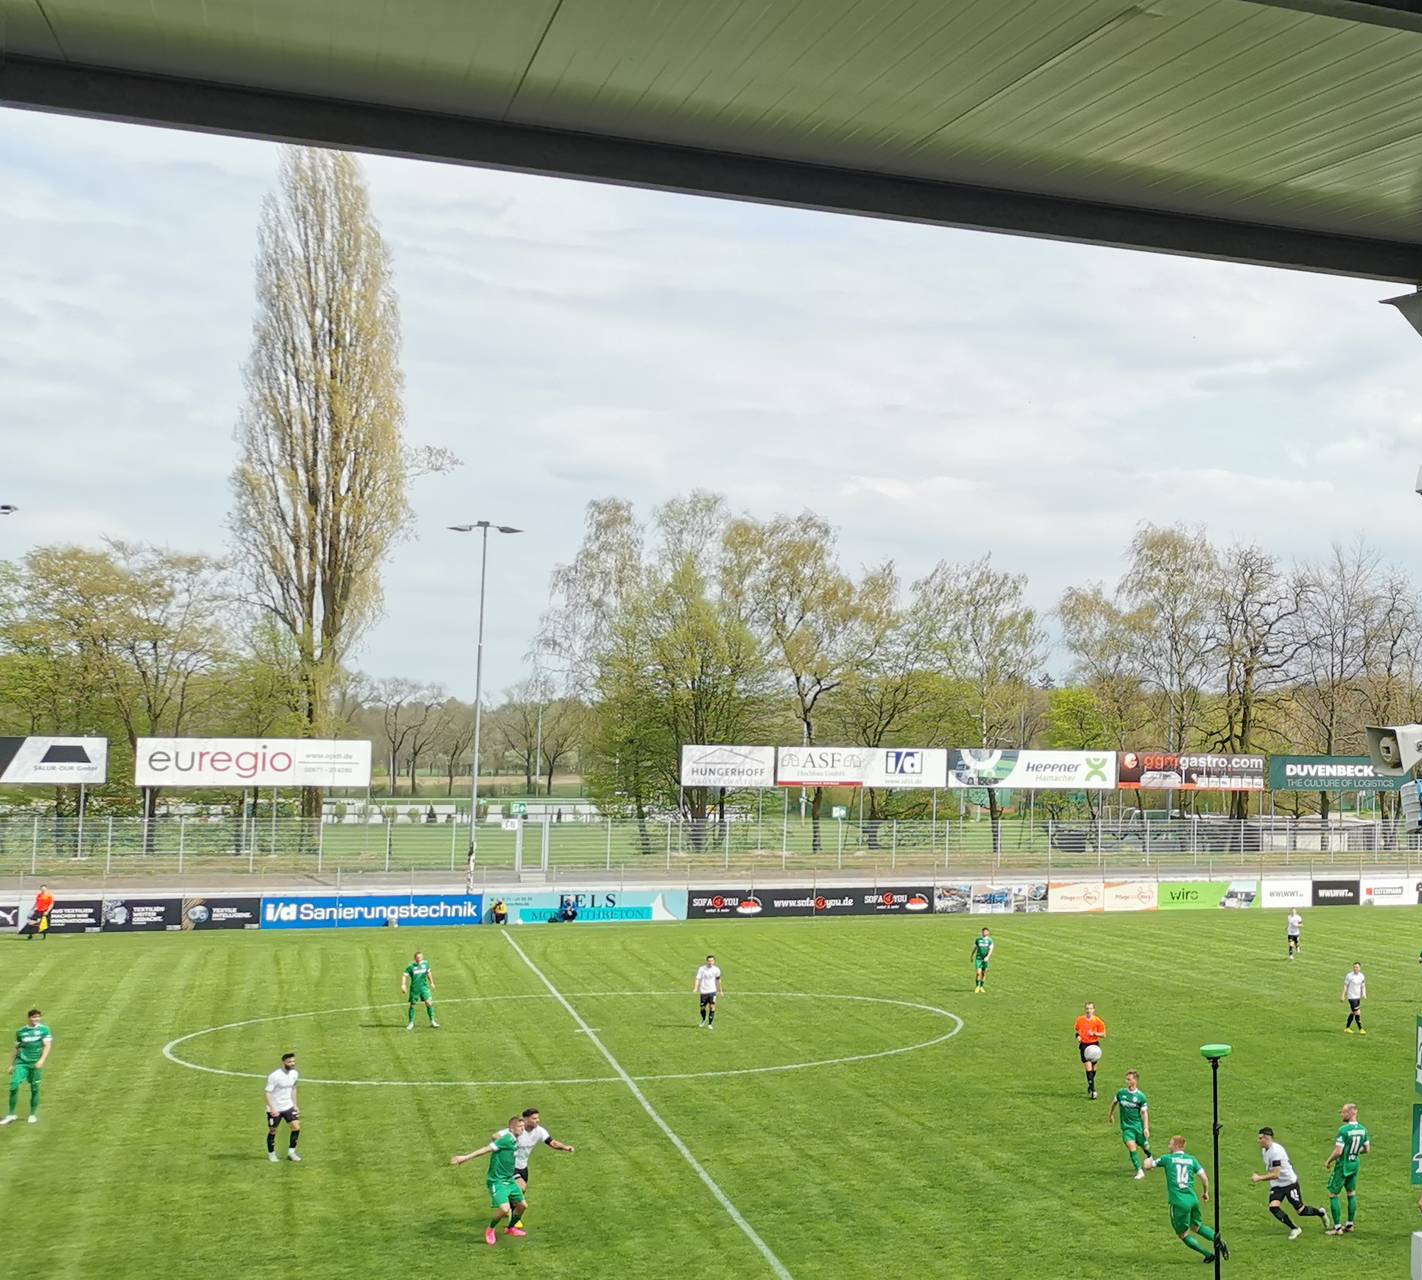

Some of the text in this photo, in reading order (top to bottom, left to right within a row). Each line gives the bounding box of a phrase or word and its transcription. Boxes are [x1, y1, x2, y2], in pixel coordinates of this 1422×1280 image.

[150, 744, 292, 778] euregio
[803, 752, 842, 768] ASF
[1144, 755, 1264, 770] ggmgastro.com
[691, 767, 766, 776] HUNGERHOFF
[1286, 764, 1374, 776] DUVENBECK
[1287, 779, 1394, 788] THE CULTURE OF LOGISTICS
[266, 902, 297, 922] i/d
[300, 901, 478, 920] Sanierungstechnik
